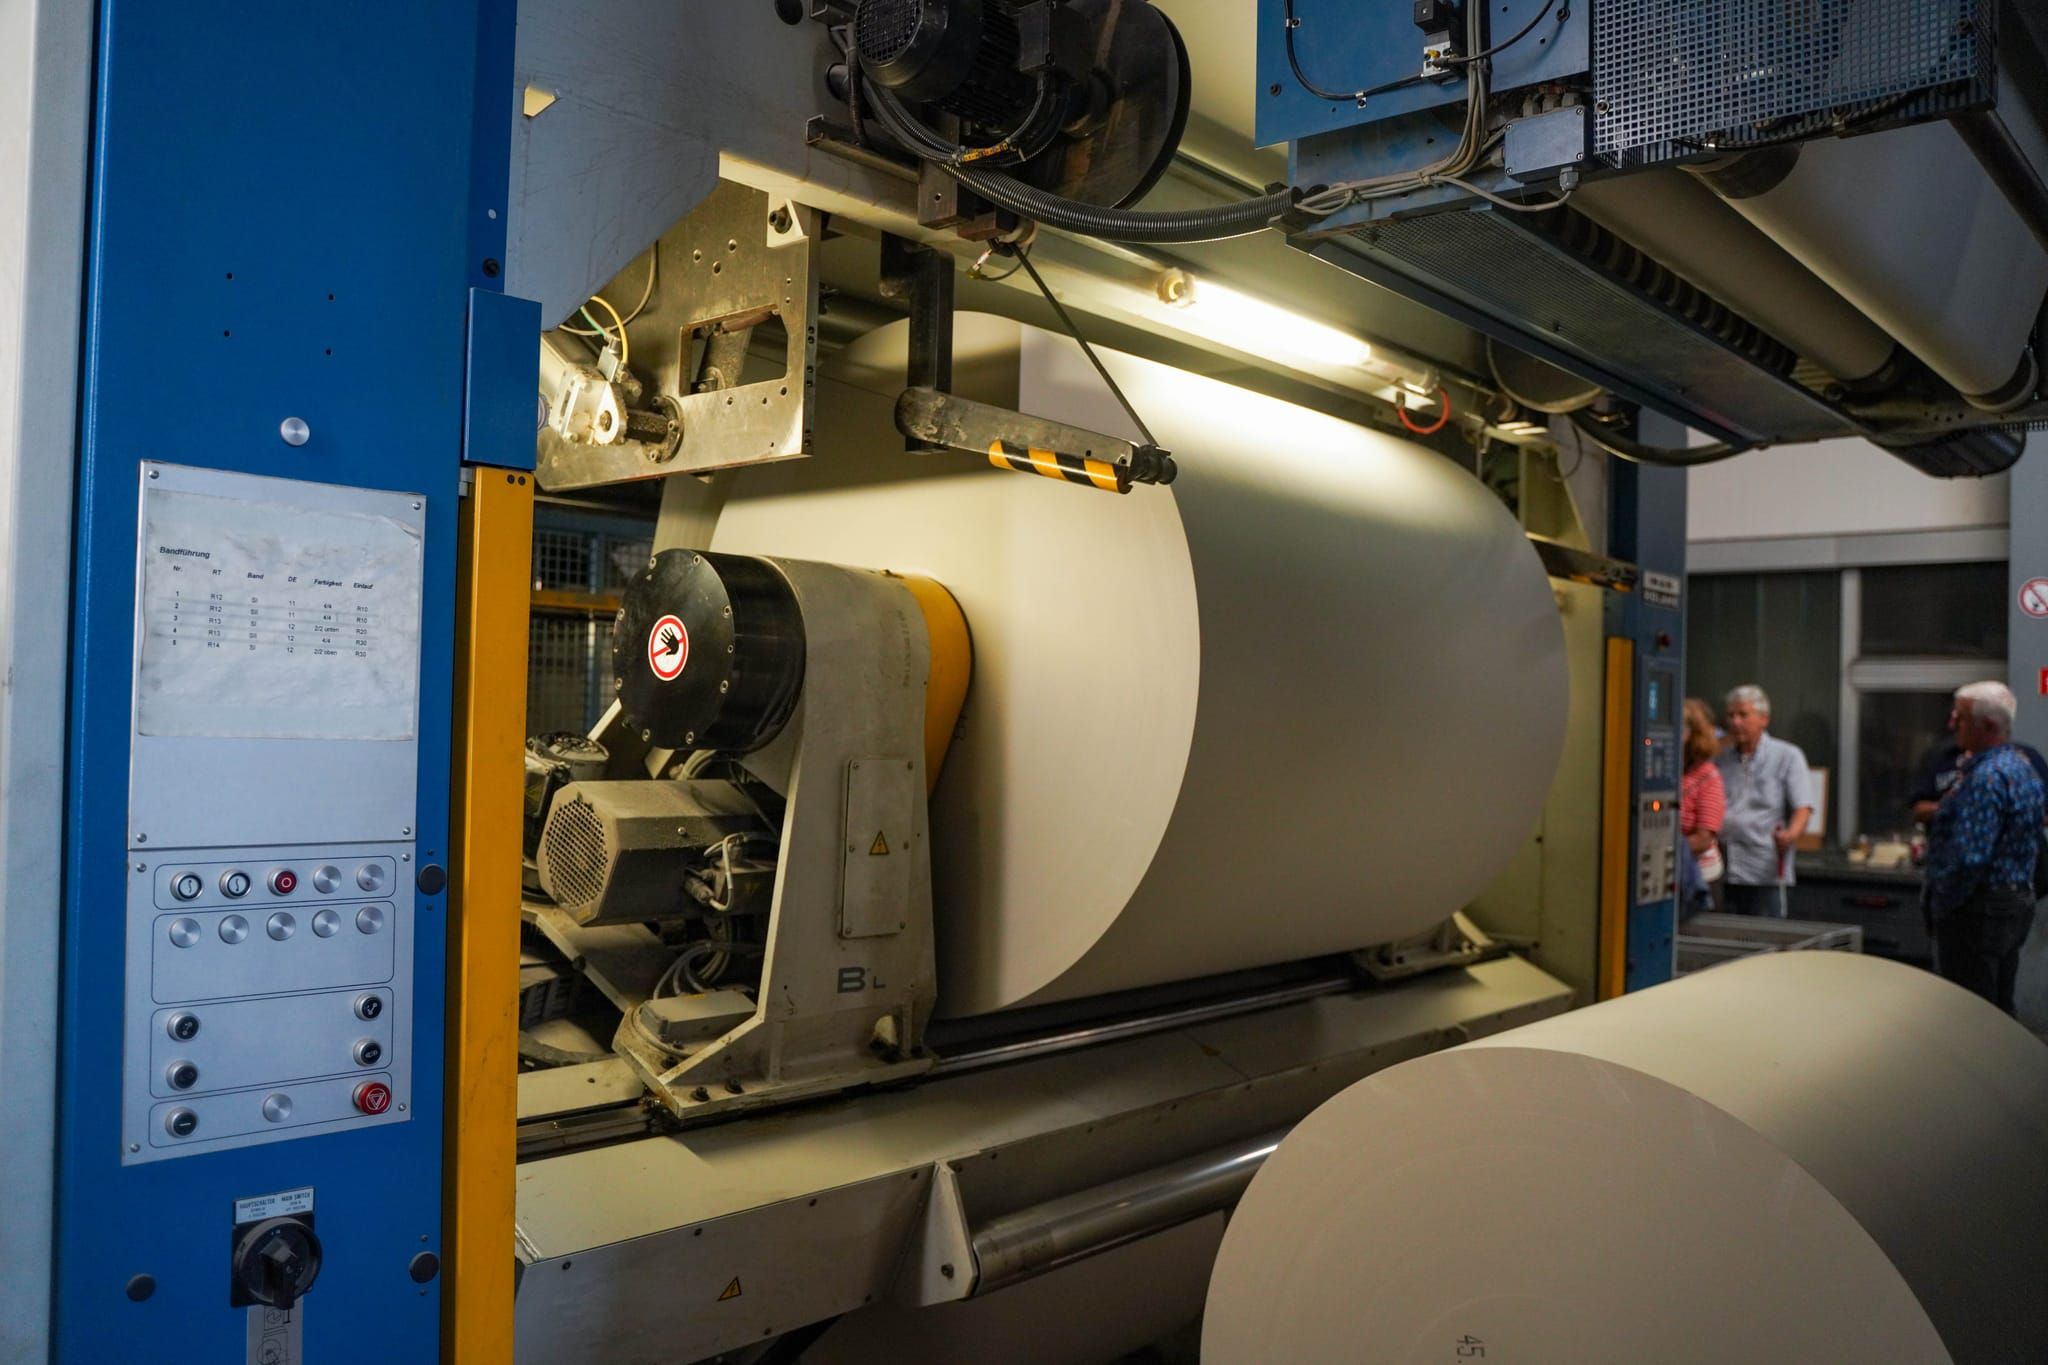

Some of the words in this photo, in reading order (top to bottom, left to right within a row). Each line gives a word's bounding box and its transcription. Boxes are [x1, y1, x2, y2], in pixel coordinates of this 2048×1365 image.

[159, 546, 210, 559] Bandführung
[248, 572, 264, 580] Band
[314, 579, 342, 587] Farbigkeit
[354, 582, 373, 590] Einlauf
